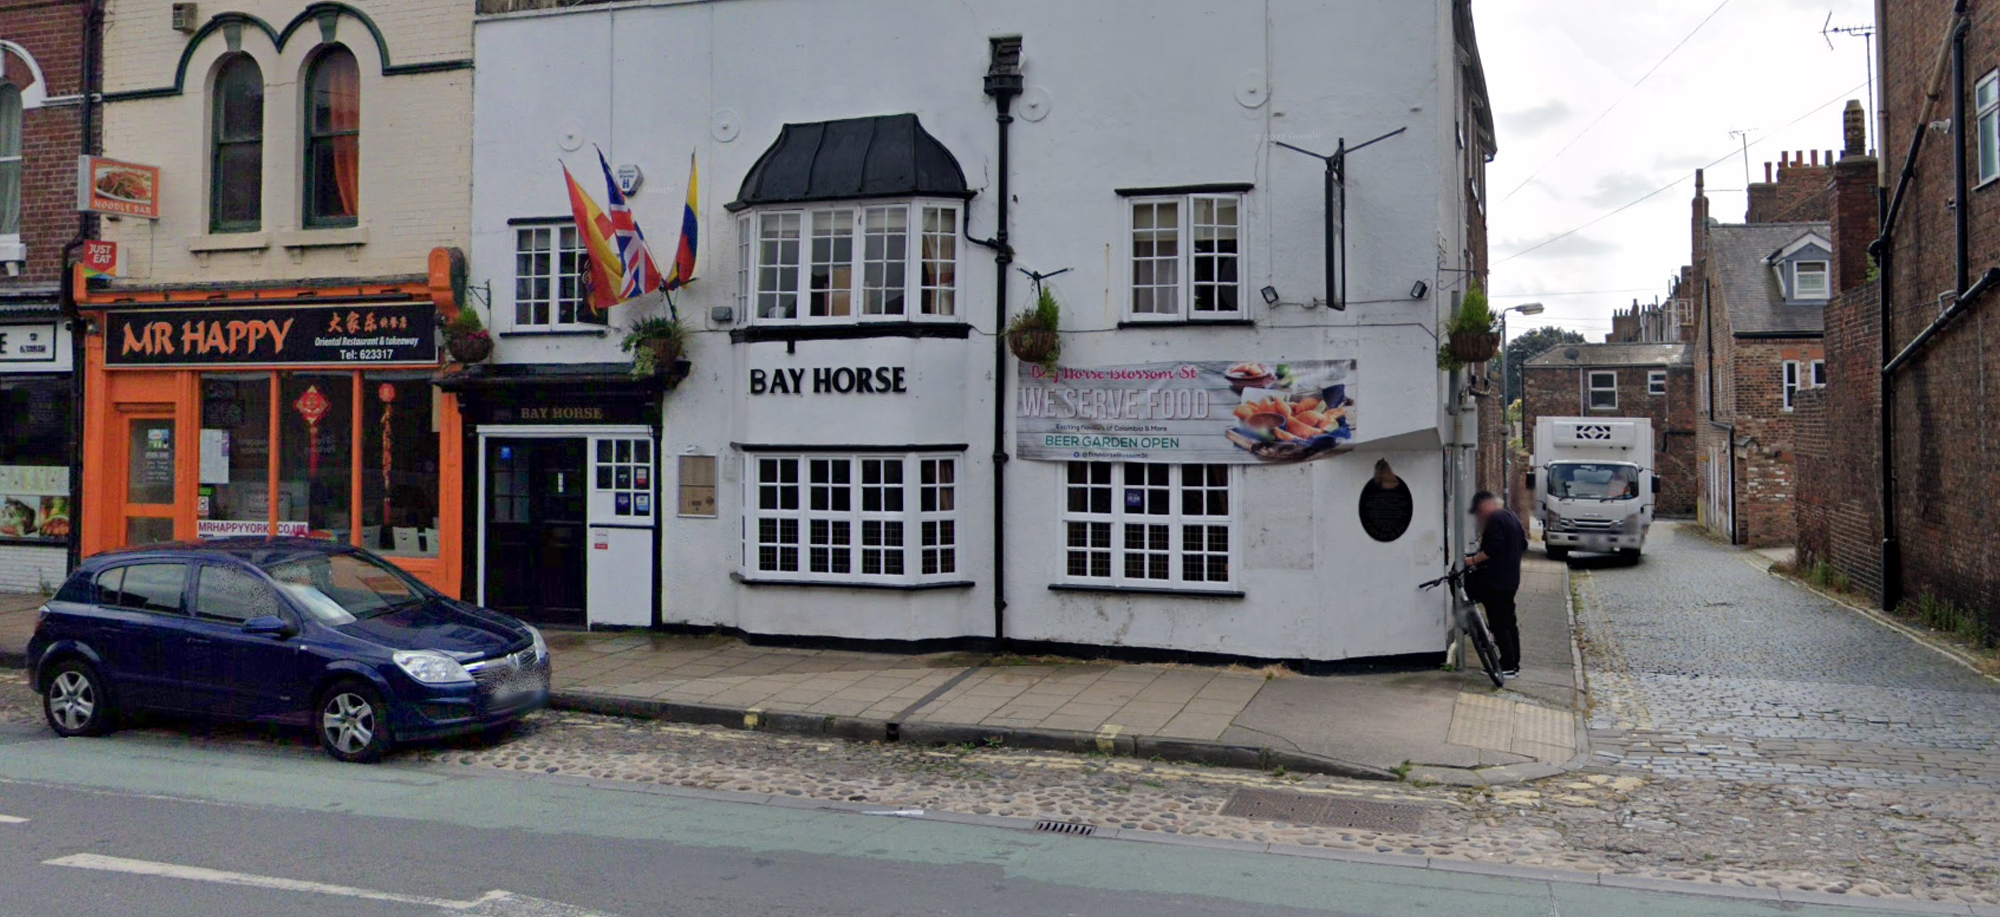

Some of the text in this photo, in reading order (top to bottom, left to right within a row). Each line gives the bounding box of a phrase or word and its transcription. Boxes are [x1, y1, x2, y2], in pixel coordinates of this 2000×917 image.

[94, 200, 152, 214] NOODLE BAR
[88, 243, 112, 254] JUST
[93, 254, 112, 264] EAT
[122, 318, 294, 356] MR HAPPY
[314, 335, 419, 347] Oriental Restaurant & takeaway
[340, 349, 393, 360] Tel: 623317
[750, 366, 907, 394] BAY HORSE
[1031, 365, 1197, 384] By Horse Blossom St
[1021, 387, 1210, 420] WE SERVE FOOD
[521, 407, 602, 419] BAY HORSE
[1056, 423, 1080, 432] Exciting
[1106, 424, 1113, 432] of
[1114, 424, 1144, 432] Colombia
[1045, 435, 1180, 449] BEER GARDEN OPEN
[198, 521, 307, 534] MRHAPPYYORKCO.UK
